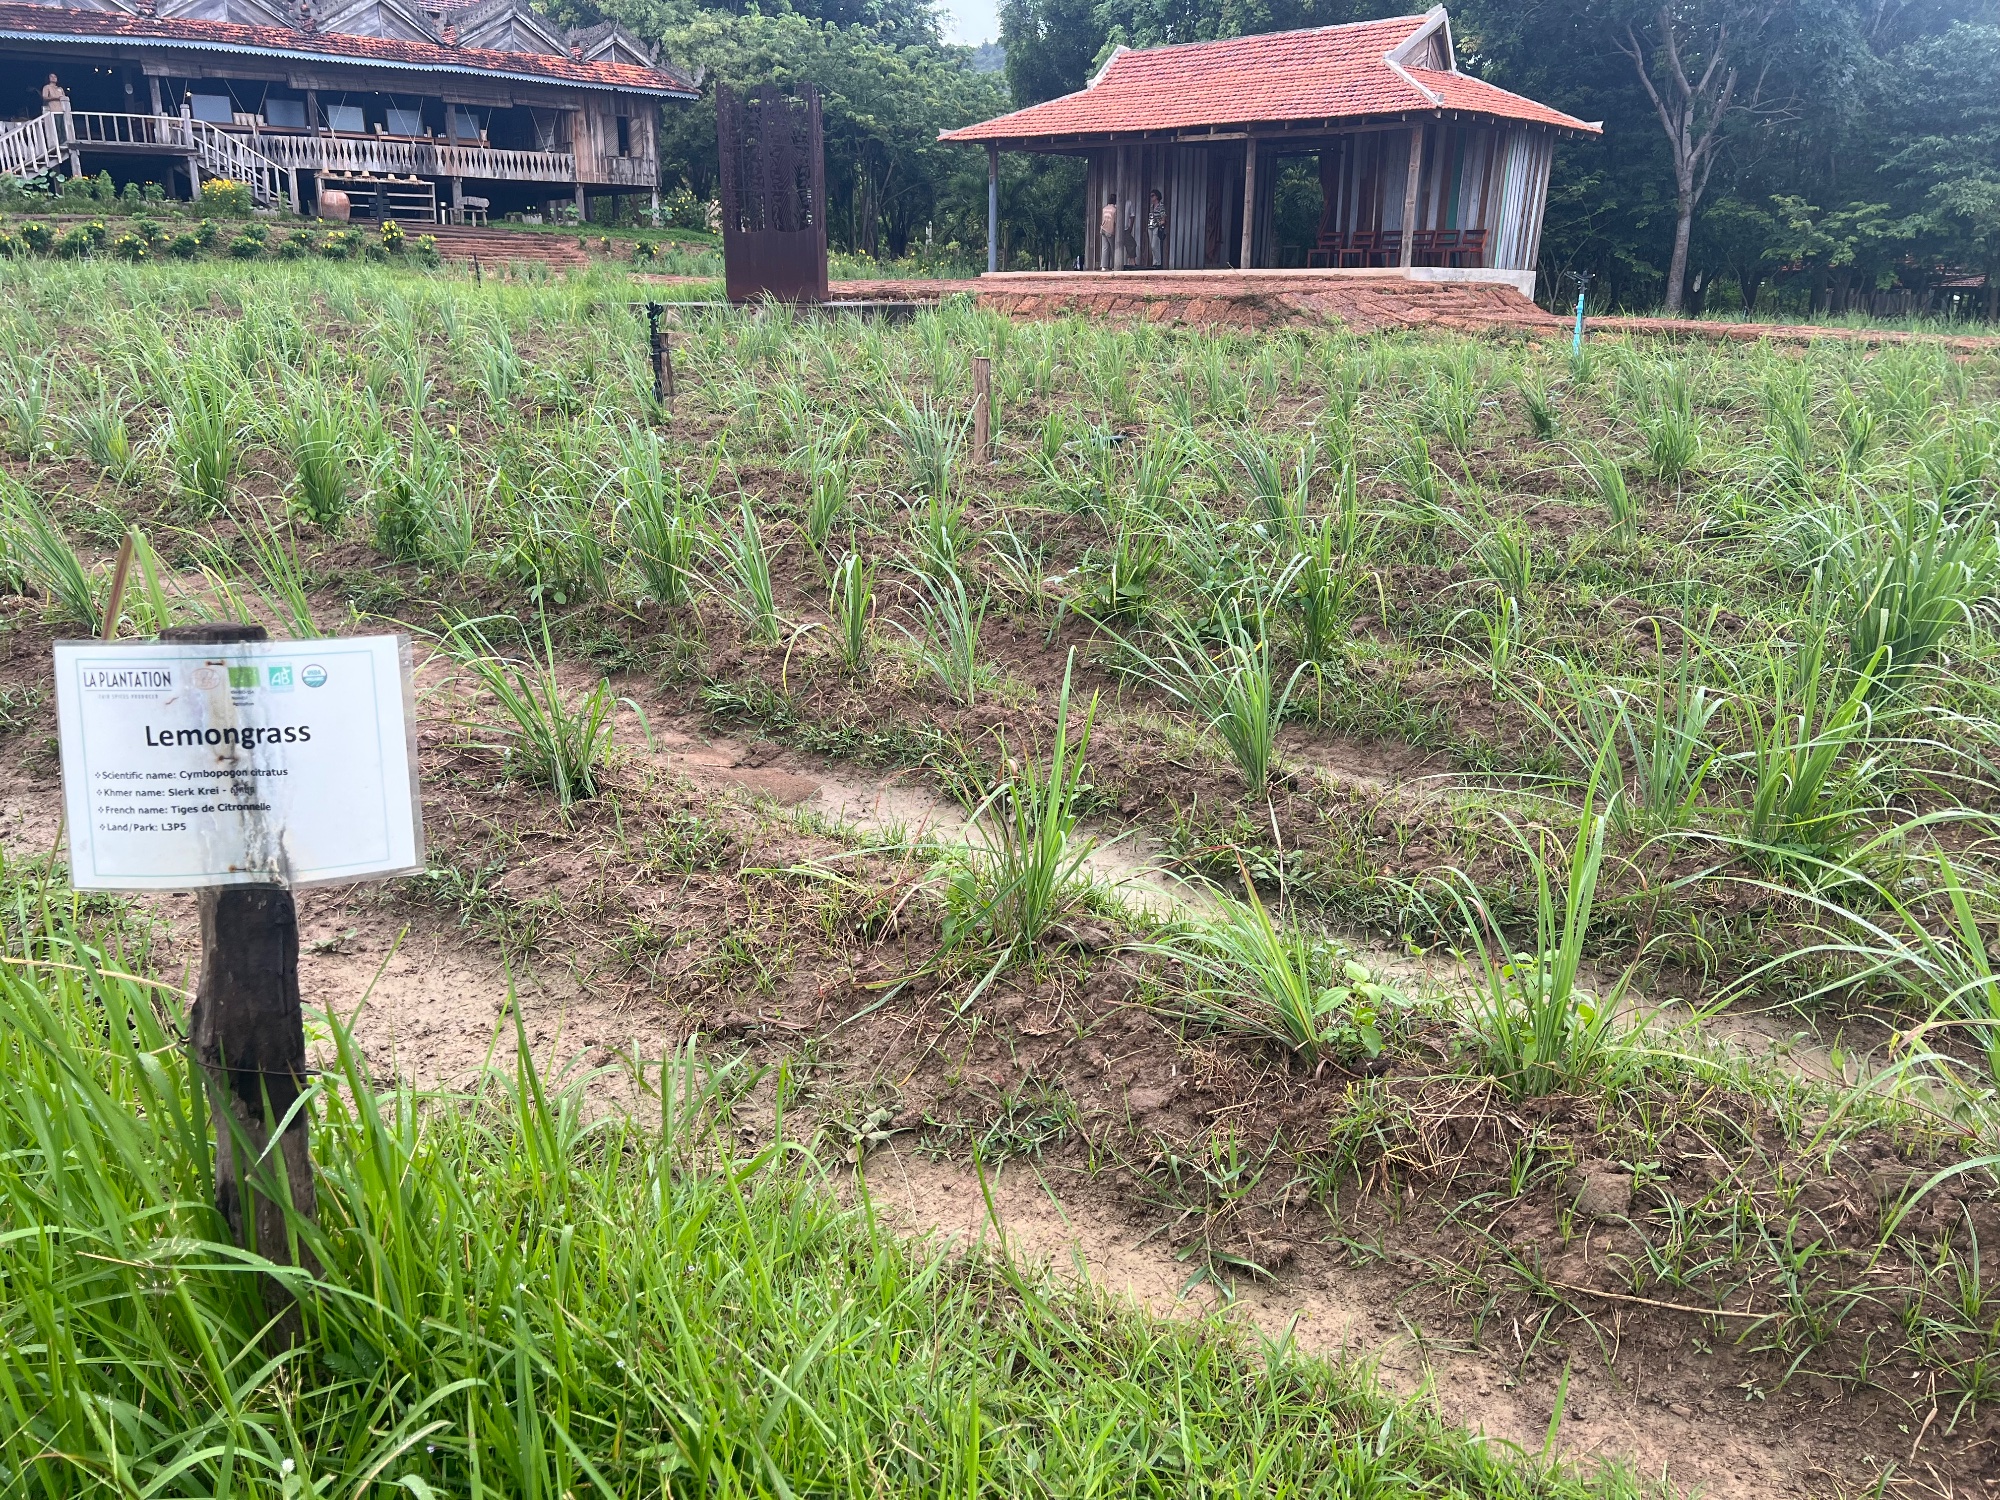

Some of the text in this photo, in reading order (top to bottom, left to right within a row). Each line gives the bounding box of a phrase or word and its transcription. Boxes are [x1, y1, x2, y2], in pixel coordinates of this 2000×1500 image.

[83, 671, 172, 688] LA PLANTATION
[145, 725, 311, 750] Lemongrass
[102, 771, 143, 780] Scientific
[179, 769, 248, 781] Cymbopogon
[250, 768, 289, 778] citratus
[103, 788, 133, 797] Khmer
[135, 788, 165, 797] name:
[168, 788, 194, 797] Slerk
[198, 786, 219, 796] Krei
[105, 803, 272, 816] French name: Tiges de Citronnelle
[107, 823, 158, 833] Land/Park:
